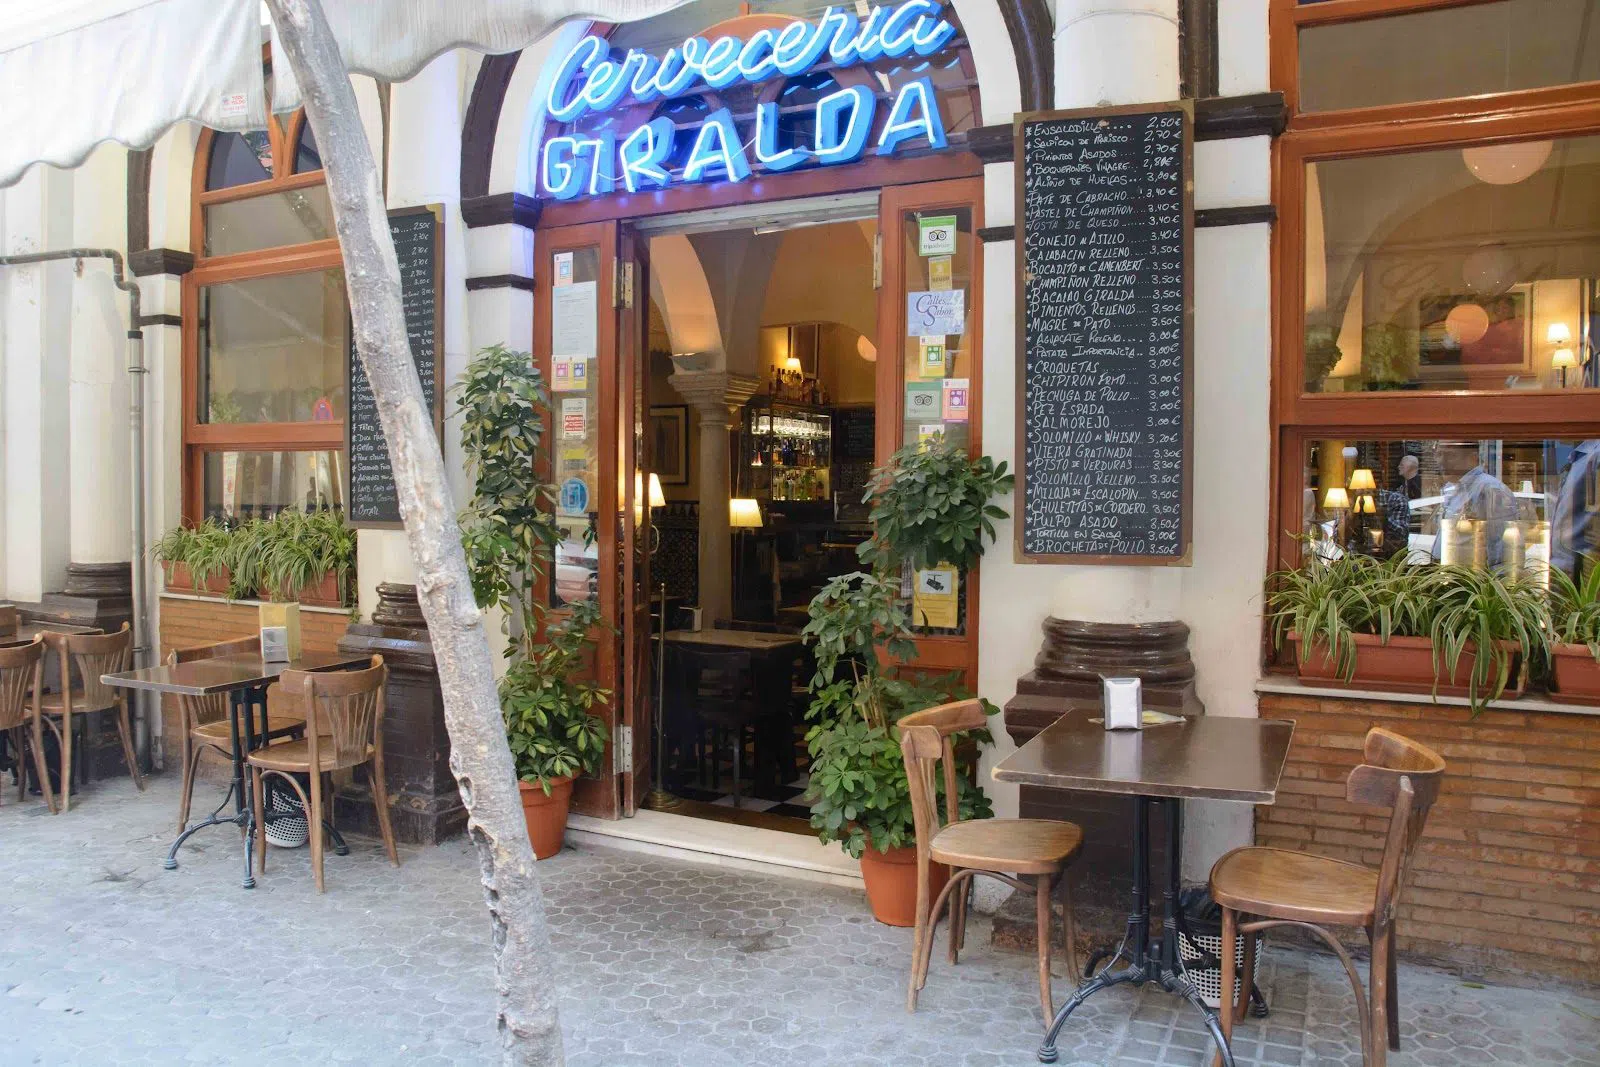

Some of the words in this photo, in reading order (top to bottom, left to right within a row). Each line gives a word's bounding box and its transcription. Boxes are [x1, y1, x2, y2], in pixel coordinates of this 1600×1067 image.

[546, 0, 958, 123] Cerveceria
[542, 76, 949, 199] GIRALDA
[1094, 134, 1128, 144] MARISCO
[1032, 149, 1073, 160] PIMIENTOS
[1079, 148, 1116, 162] ASADOS
[1032, 162, 1092, 174] BOQUERONES
[1070, 178, 1082, 186] DE
[1060, 194, 1072, 204] DE
[1076, 190, 1127, 204] CABRACHO
[1029, 204, 1061, 219] PASTEL
[1065, 208, 1077, 218] DE
[1080, 204, 1134, 217] CHAMPIÑON
[1028, 220, 1058, 231] TOSTA
[1065, 220, 1080, 230] DE
[1086, 216, 1120, 228] QUESO
[1028, 232, 1076, 246] CONEJO
[1088, 231, 1125, 246] AJILLO
[1027, 247, 1086, 260] CALABACIN
[1089, 246, 1130, 260] RELLENO
[1030, 260, 1078, 275] BOCADITO
[1088, 258, 1145, 272] CAMENBERT
[1032, 274, 1090, 290] CHAMPIÑON
[1092, 274, 1136, 288] RELLENO
[1030, 288, 1080, 304] BACALAO
[1084, 288, 1135, 302] GIRALDA
[1030, 302, 1086, 318] PIMIENTOS
[1092, 302, 1136, 316] RELLENOS
[1031, 318, 1068, 332] MAGRE
[1083, 316, 1111, 330] PATO
[1036, 332, 1084, 346] AGUACATE
[1032, 346, 1068, 358] PATATA
[1072, 346, 1136, 358] IMPORTANCIA
[1034, 360, 1100, 374] CROQUETAS
[1032, 374, 1096, 387] CHIPIRON
[1098, 372, 1126, 386] FRITO
[1032, 386, 1080, 402] PECHUGA
[1084, 390, 1096, 401] DE
[1100, 386, 1130, 401] POLLO
[1032, 401, 1054, 416] PEZ
[1060, 400, 1104, 416] ESPADA
[1033, 414, 1110, 429] SALMOREJO
[1032, 428, 1092, 444] SOLOMILLO
[1104, 430, 1141, 444] WHISKY
[1033, 444, 1072, 458] VIEIRA
[1076, 444, 1133, 458] GRATINADA
[1033, 458, 1070, 471] PISTO
[1083, 460, 1133, 471] VERDURAS
[1032, 470, 1090, 486] SOLOMILLO
[1094, 470, 1136, 486] RELLENO
[1072, 488, 1081, 496] DE
[1084, 485, 1139, 500] ESCALOPIN
[1032, 499, 1094, 514] CHULETITAS
[1102, 500, 1146, 514] CORDERO
[1032, 512, 1071, 528] PULPO
[1080, 514, 1118, 528] ASADO
[1032, 527, 1069, 540] TORTILLA
[1074, 530, 1088, 538] EN
[1091, 530, 1122, 540] SALSA
[1033, 540, 1098, 554] BROCHETA
[1109, 538, 1145, 554] POLLO
